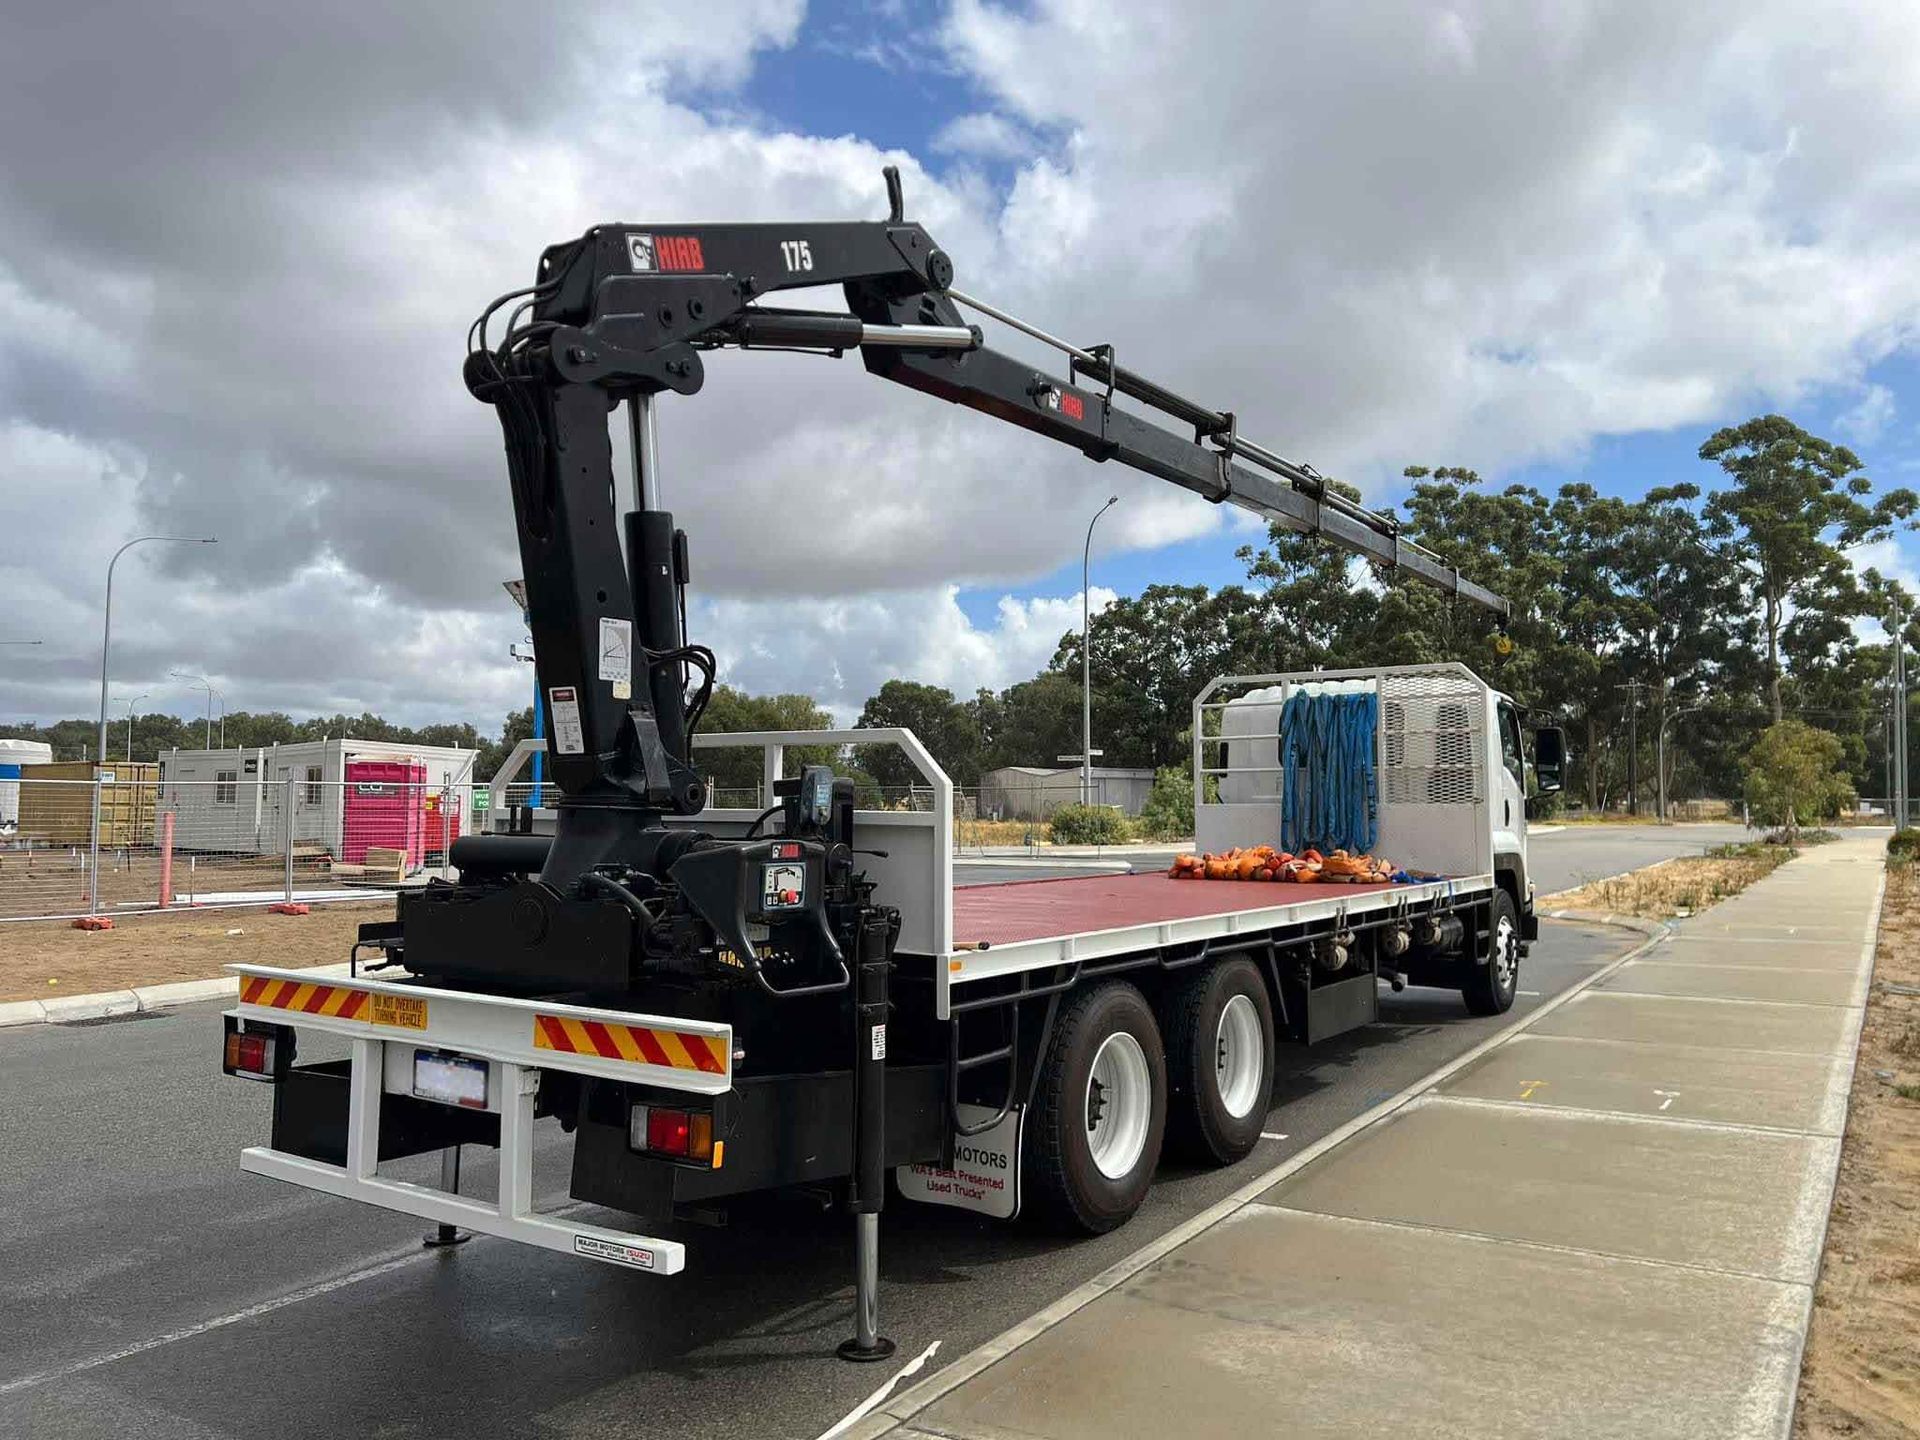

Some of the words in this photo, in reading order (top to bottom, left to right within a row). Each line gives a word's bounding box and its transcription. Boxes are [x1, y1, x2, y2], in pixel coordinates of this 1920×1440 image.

[655, 236, 704, 270] HIAB
[780, 240, 813, 272] 175
[374, 993, 382, 1007] DO
[383, 995, 394, 1009] NOT
[395, 997, 422, 1014] OVERTAKE
[399, 1011, 421, 1027] VEHICLE
[954, 1147, 1007, 1169] MOTORS
[926, 1180, 952, 1193] Used
[959, 1170, 1004, 1190] Presented
[599, 1243, 625, 1254] MOTORS
[626, 1249, 651, 1260] ISUZU
